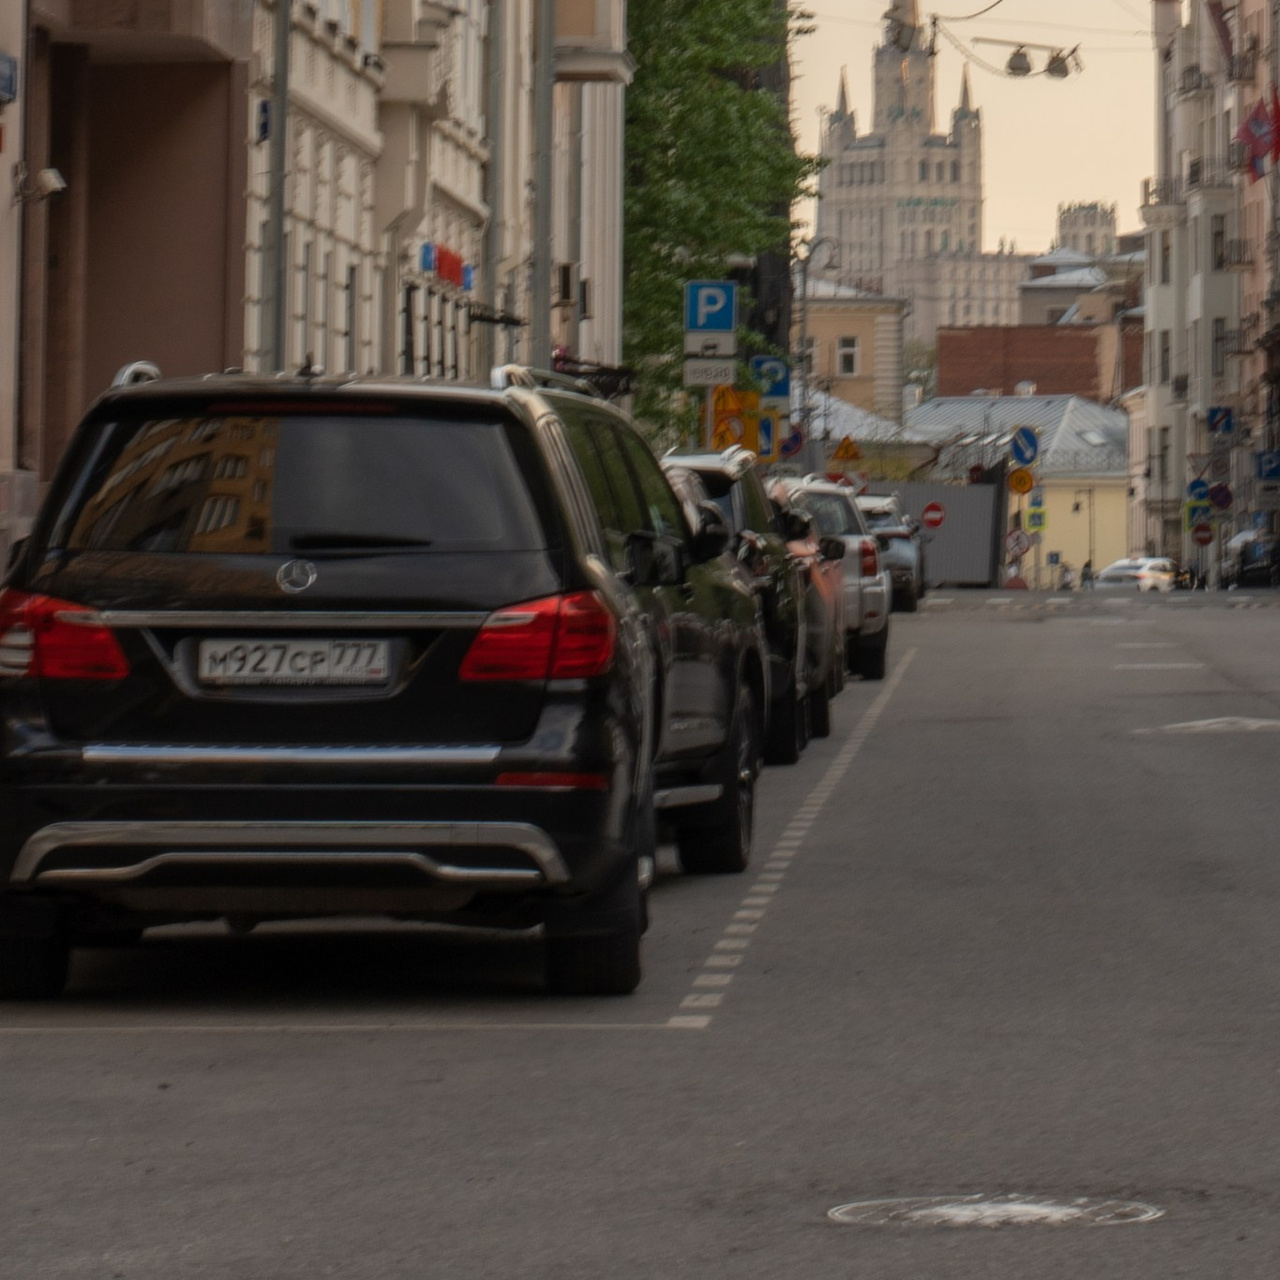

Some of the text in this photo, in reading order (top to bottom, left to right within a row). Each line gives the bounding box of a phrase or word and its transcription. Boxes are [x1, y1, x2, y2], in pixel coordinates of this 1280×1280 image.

[697, 287, 726, 327] P
[760, 361, 786, 392] P
[332, 642, 379, 666] 777
